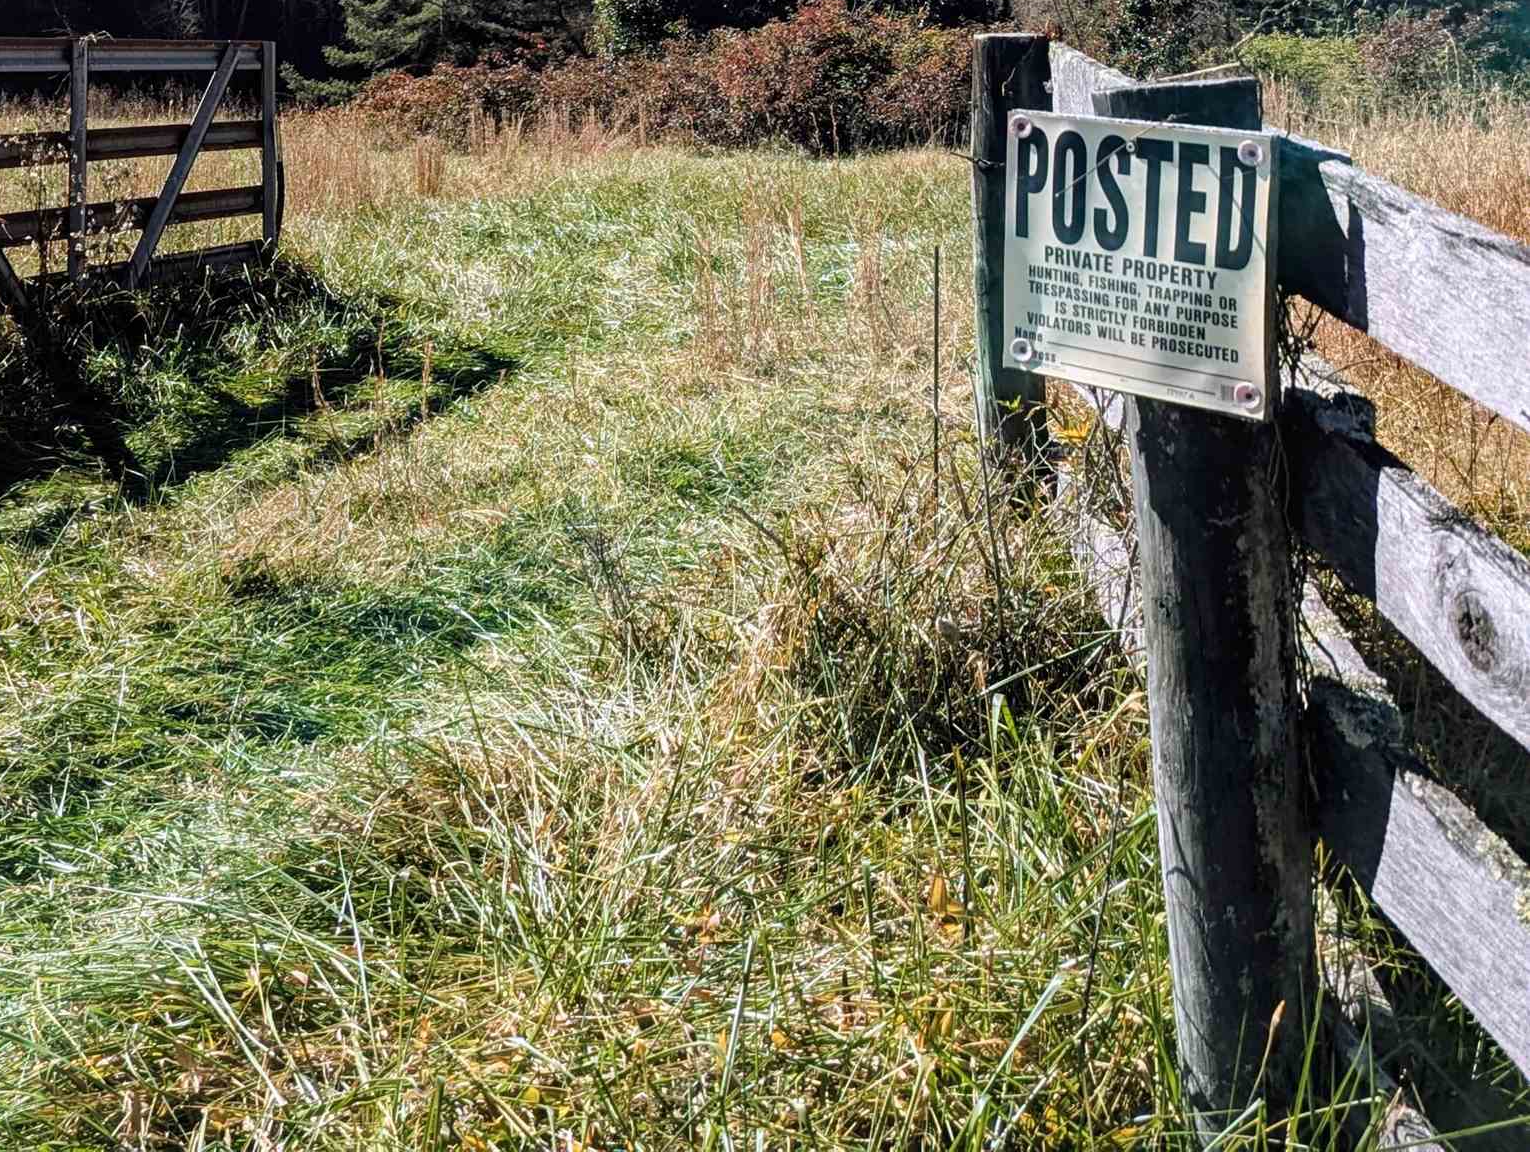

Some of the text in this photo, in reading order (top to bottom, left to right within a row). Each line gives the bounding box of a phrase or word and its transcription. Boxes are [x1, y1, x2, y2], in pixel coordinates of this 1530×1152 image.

[1016, 125, 1257, 271] POSTED
[1029, 264, 1238, 312] HUNTING, FISHING, TRAPPING OR
[1045, 245, 1217, 290] PRIVATE PROPERTY
[1028, 279, 1238, 329] TRESPASSING FOR ANY PURPOSE
[1054, 300, 1206, 341] IS STRICTLY FORBIDDEN
[1014, 326, 1044, 343] Name
[1027, 311, 1239, 363] VIOLATORS WILL BE PROSECUTED
